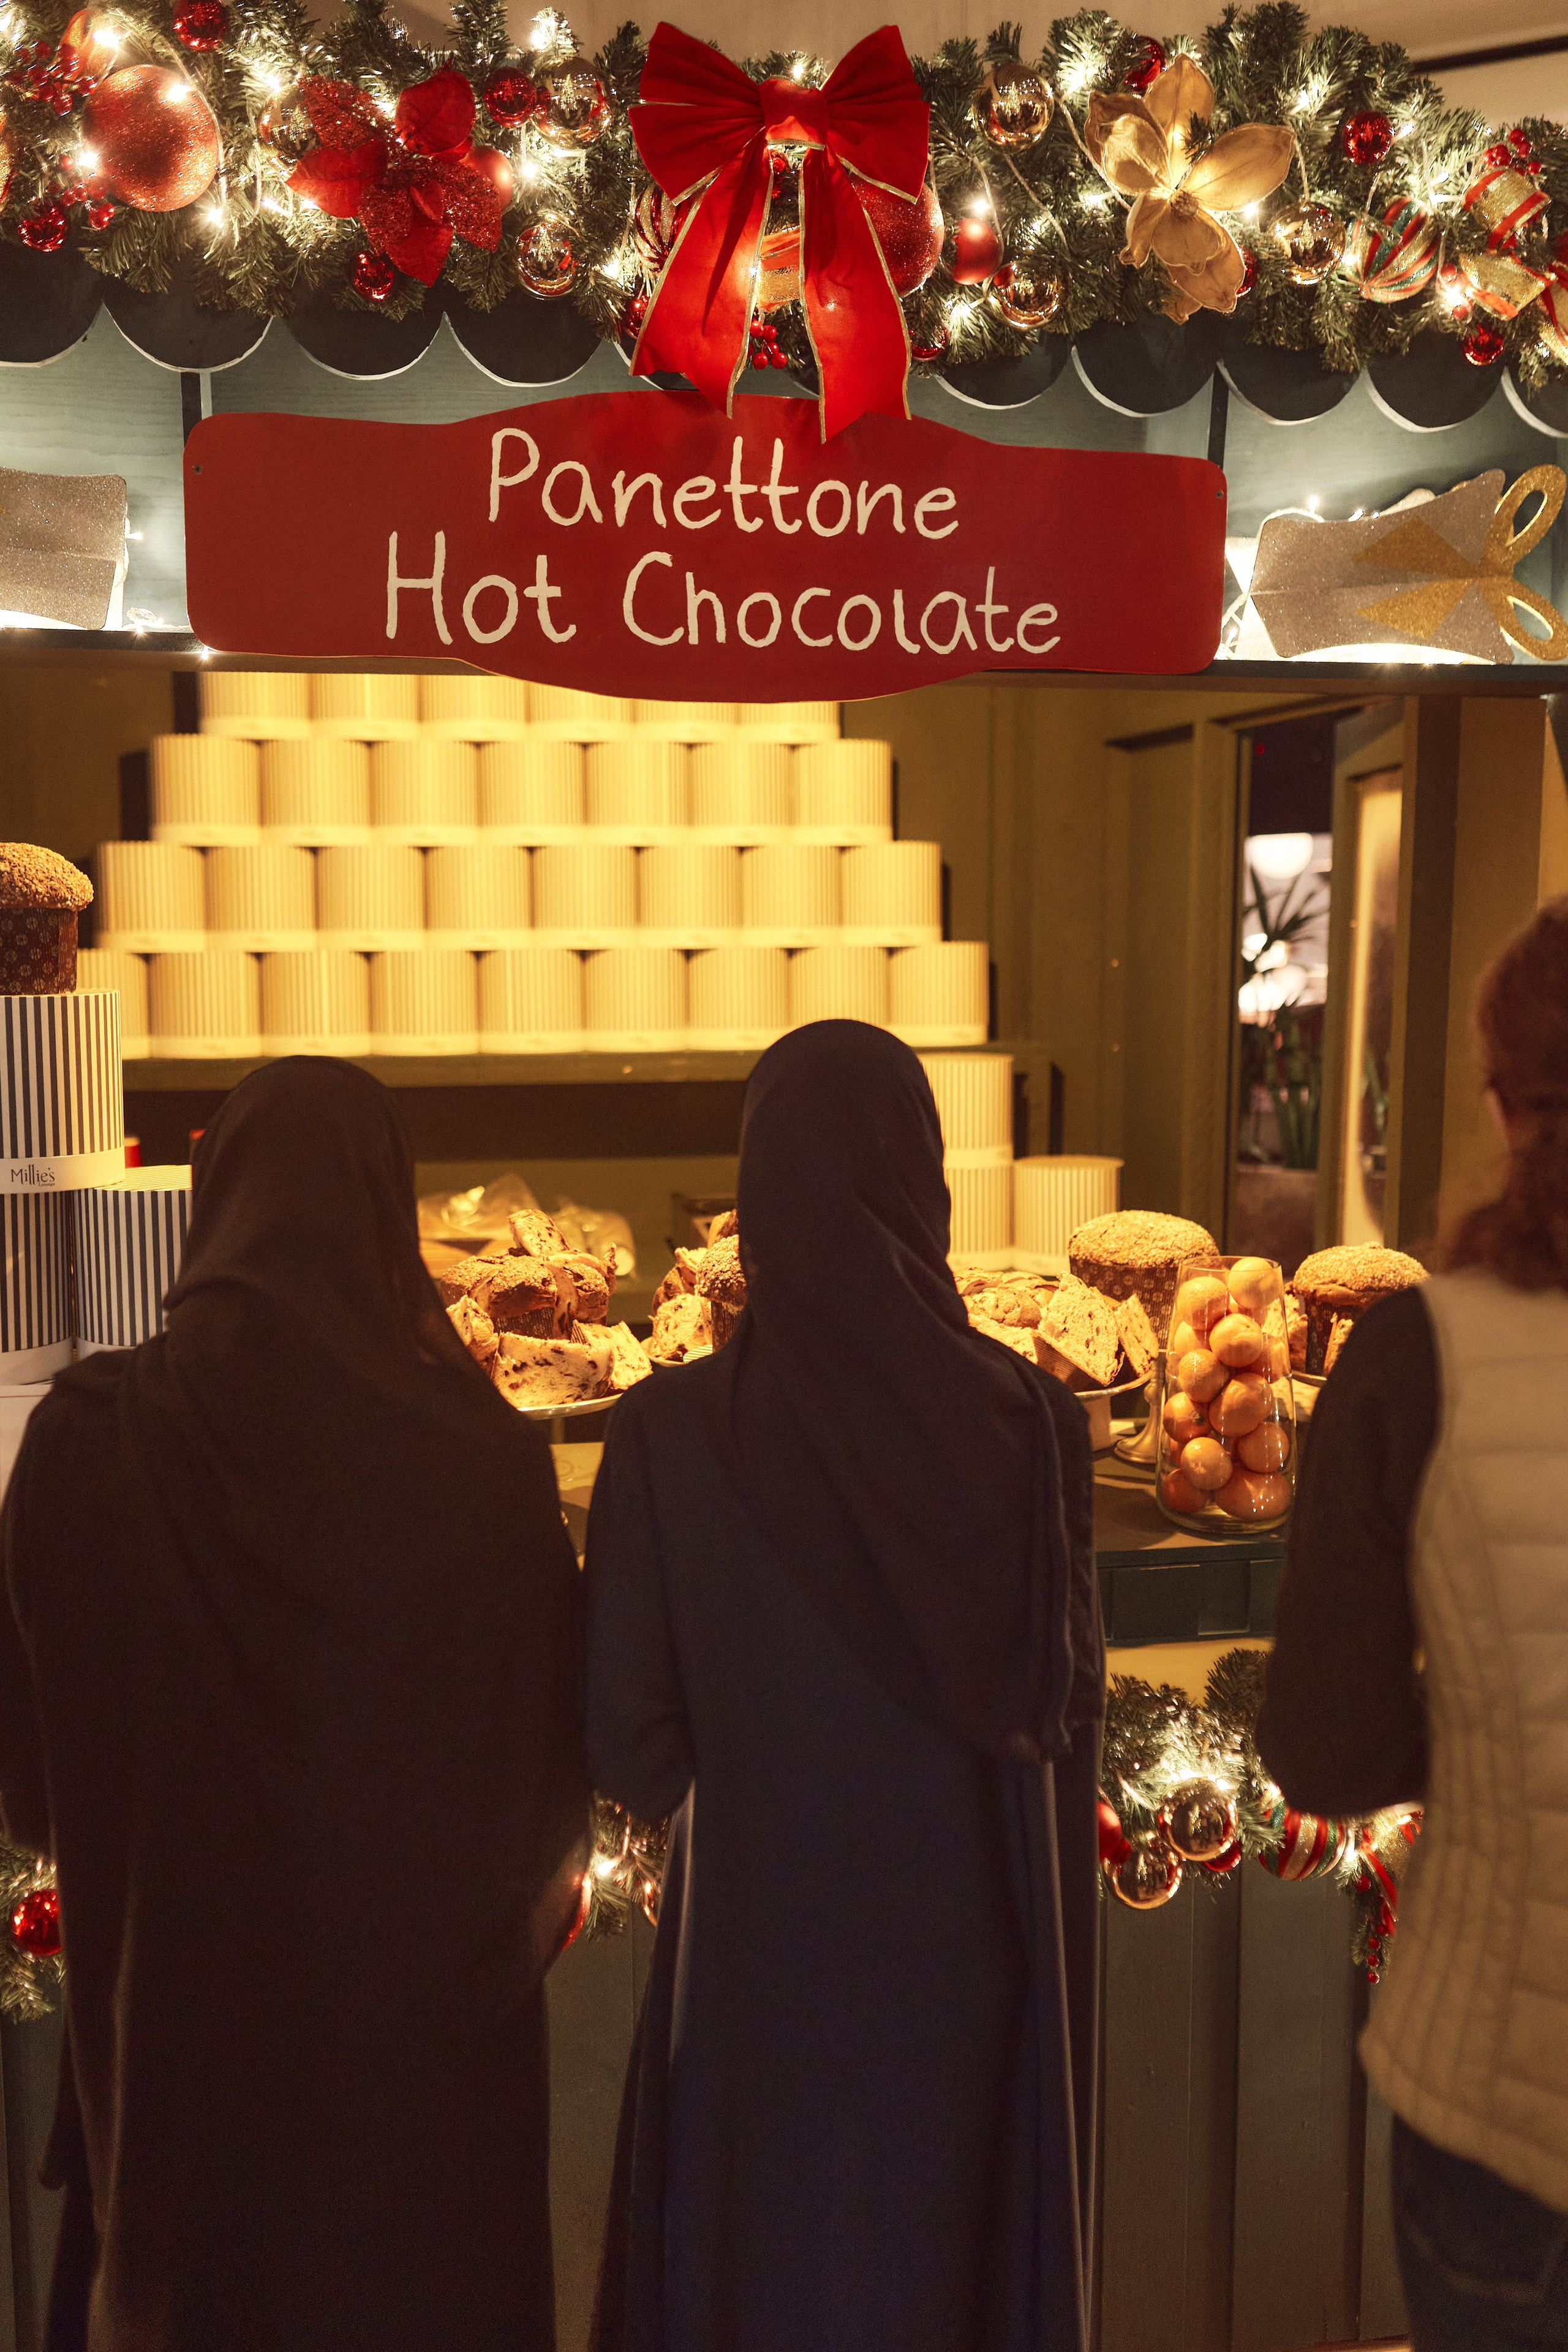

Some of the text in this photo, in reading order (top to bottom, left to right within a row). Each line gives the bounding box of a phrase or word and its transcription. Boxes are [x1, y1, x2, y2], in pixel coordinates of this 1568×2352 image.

[488, 428, 959, 540] Panettone
[386, 530, 1061, 655] Hot Chocolate
[11, 1164, 55, 1185] Millie's
